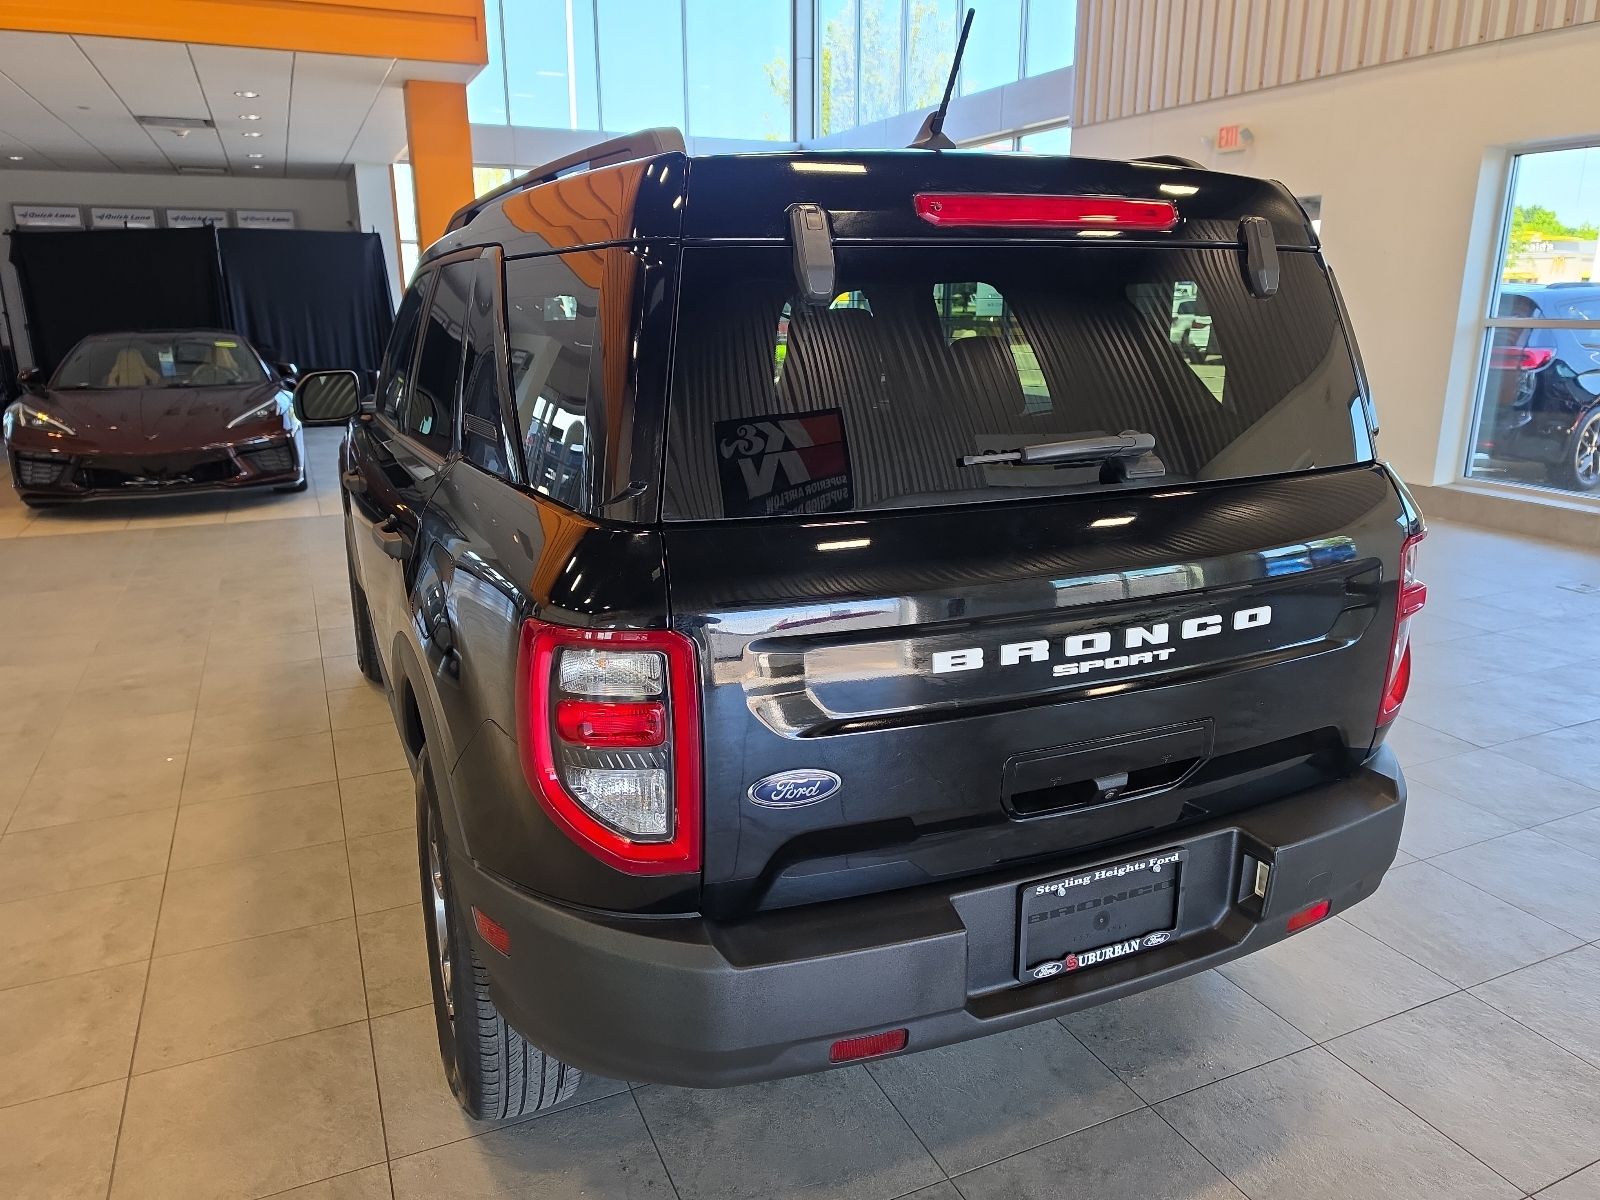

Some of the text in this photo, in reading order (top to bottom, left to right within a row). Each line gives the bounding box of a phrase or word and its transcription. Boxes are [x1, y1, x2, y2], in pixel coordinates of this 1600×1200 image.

[1219, 127, 1238, 149] EXIT
[28, 211, 53, 219] Quick
[130, 213, 151, 221] Lane
[932, 605, 1272, 674] BRONCO
[1052, 647, 1176, 677] SPORT
[771, 778, 821, 801] Ford
[1036, 853, 1179, 896] Sterling Heights Ford
[1028, 879, 1174, 925] BRONCO
[1066, 939, 1141, 973] SUBURBAN
